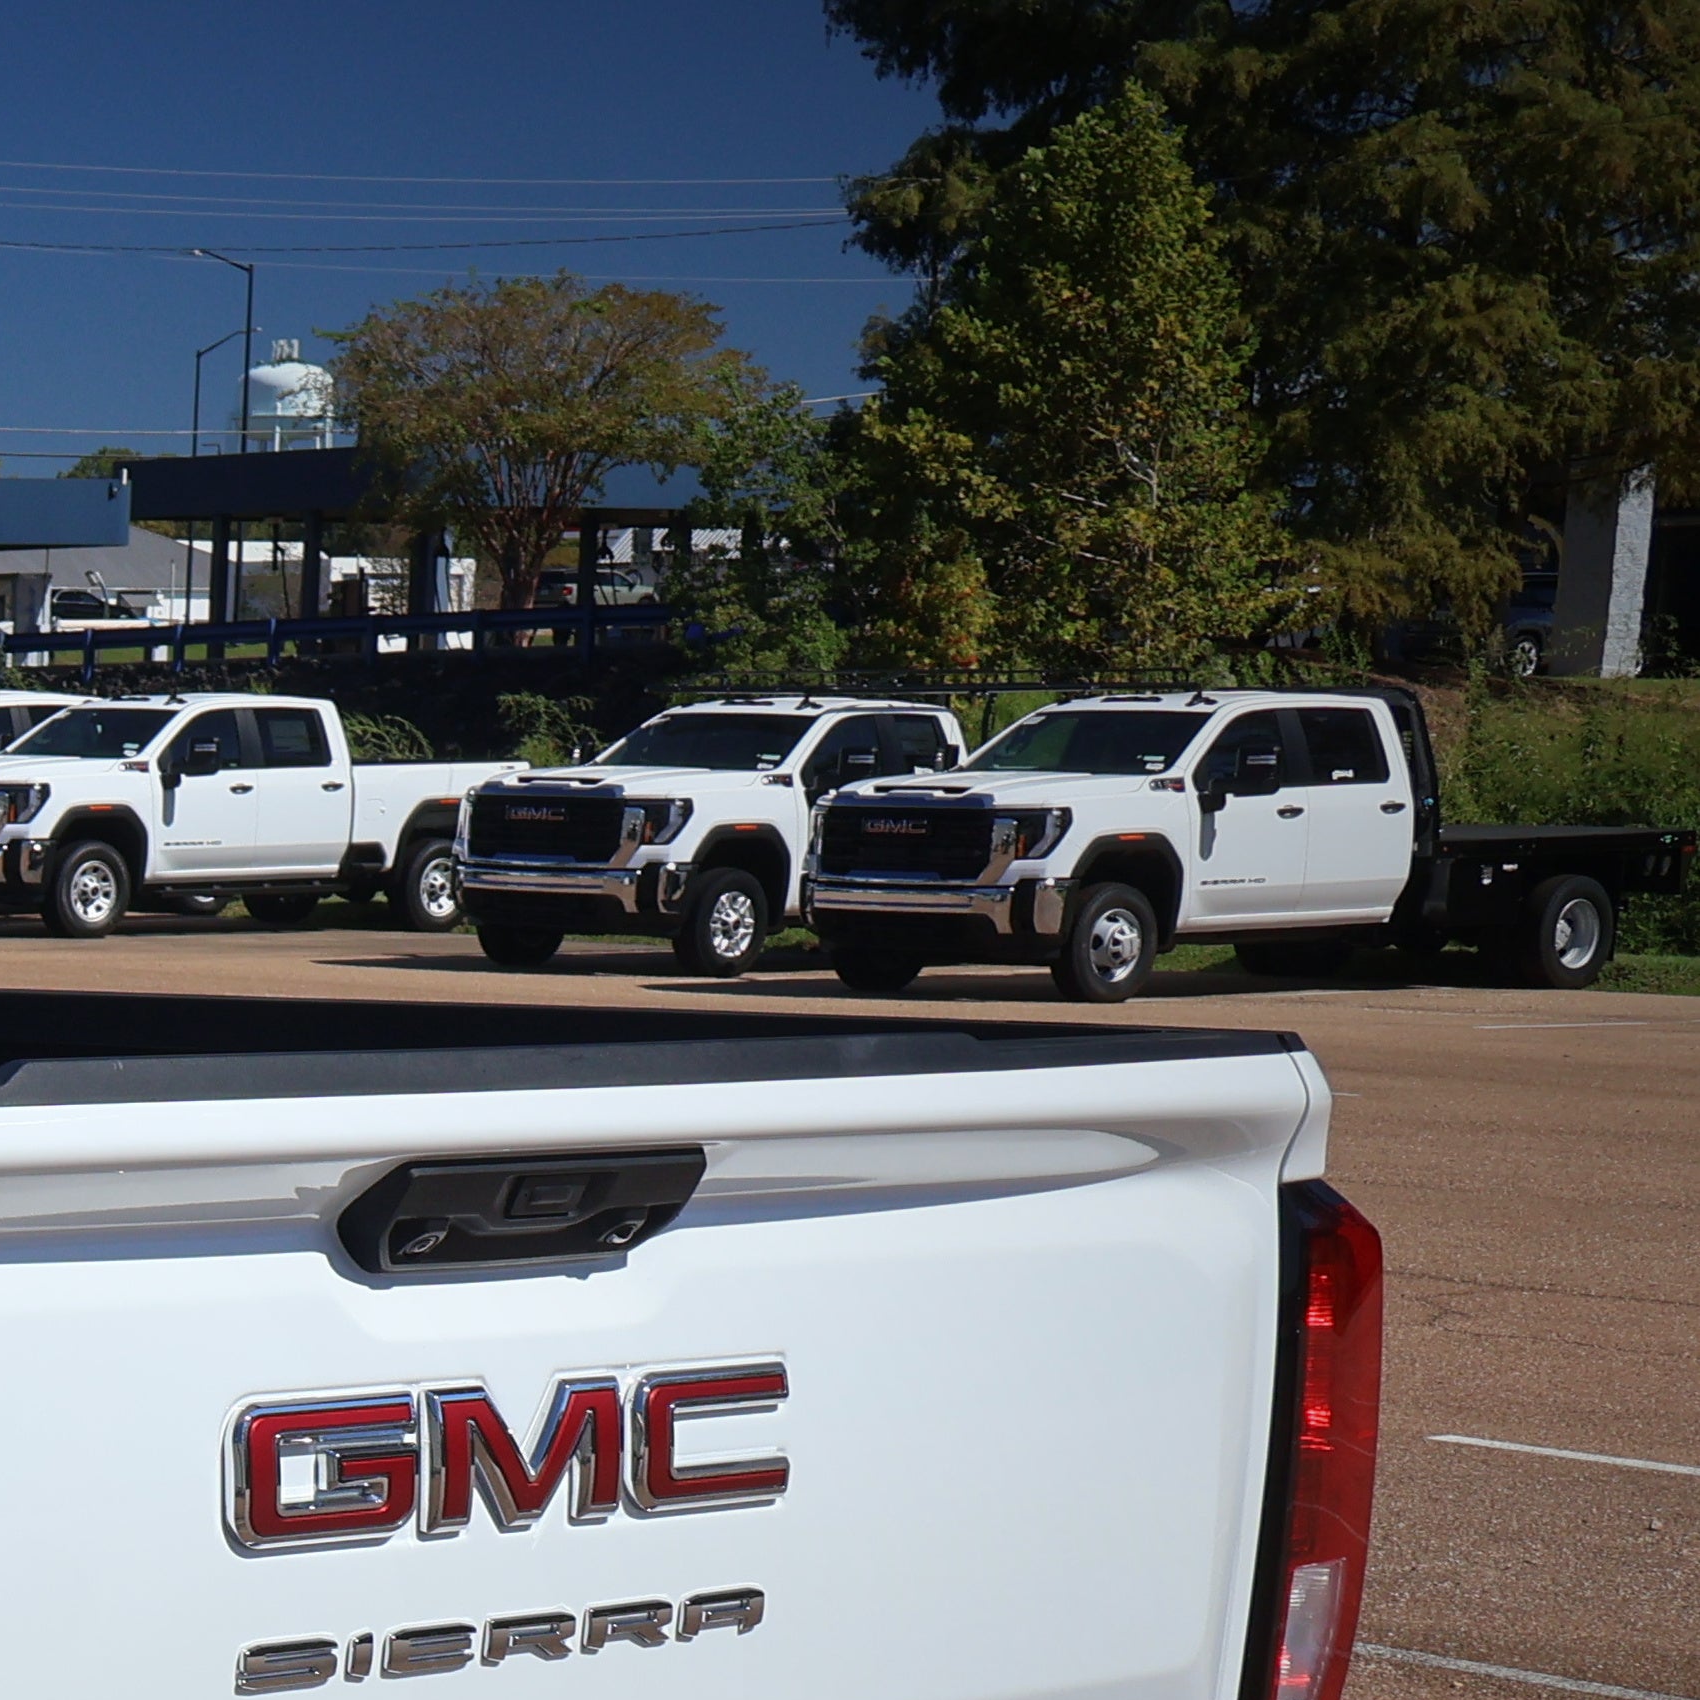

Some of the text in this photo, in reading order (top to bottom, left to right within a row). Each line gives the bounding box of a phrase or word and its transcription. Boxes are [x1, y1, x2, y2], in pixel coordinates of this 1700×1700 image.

[507, 805, 566, 821] GMC
[865, 818, 927, 835] GMC
[226, 1357, 791, 1553] GMC
[235, 1585, 766, 1695] SIERRA
